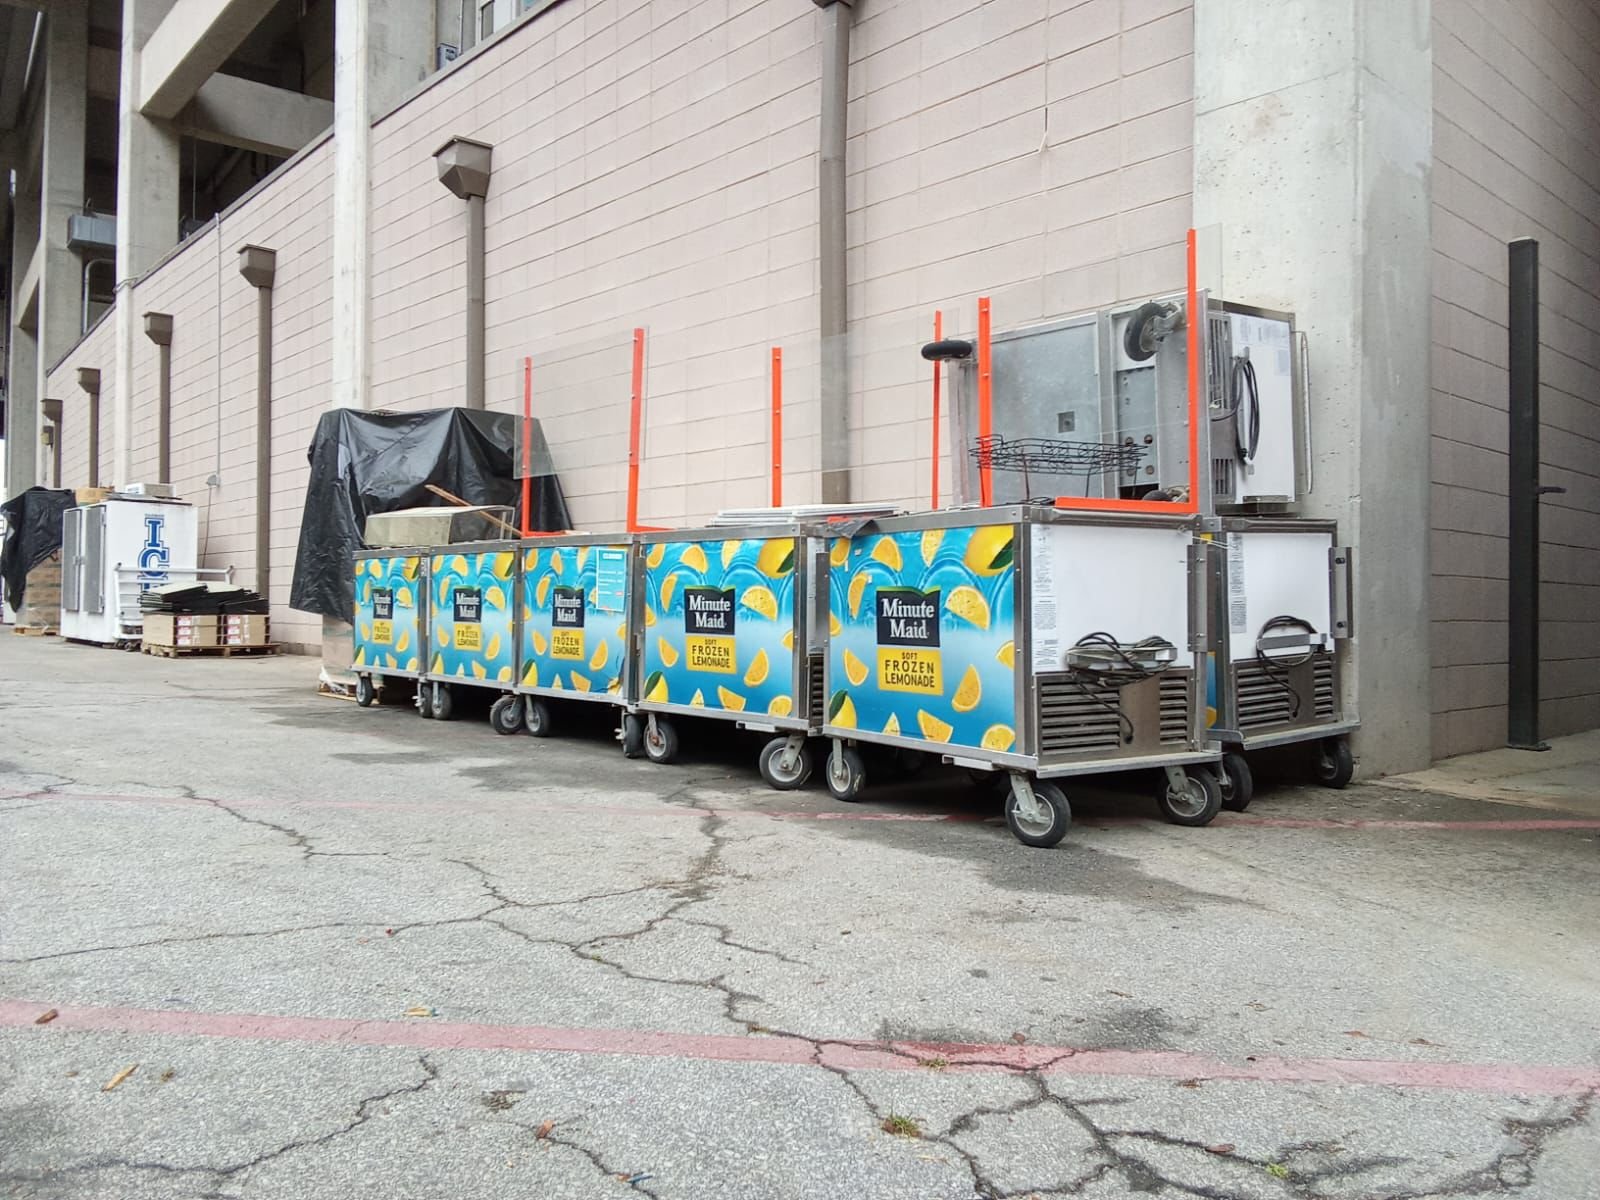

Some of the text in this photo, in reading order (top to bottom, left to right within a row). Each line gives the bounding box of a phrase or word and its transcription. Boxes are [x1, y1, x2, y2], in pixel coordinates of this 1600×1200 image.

[688, 595, 731, 611] Minute
[881, 598, 935, 618] Minute
[557, 608, 577, 623] Maid
[695, 612, 725, 628] Maid
[890, 619, 928, 639] Maid
[554, 636, 580, 646] FROZEN
[692, 645, 730, 657] FROZEN
[901, 652, 918, 660] SOFT
[692, 656, 731, 669] LEMONADE
[885, 660, 935, 675] FROZEN
[885, 672, 936, 688] LEMONADE
